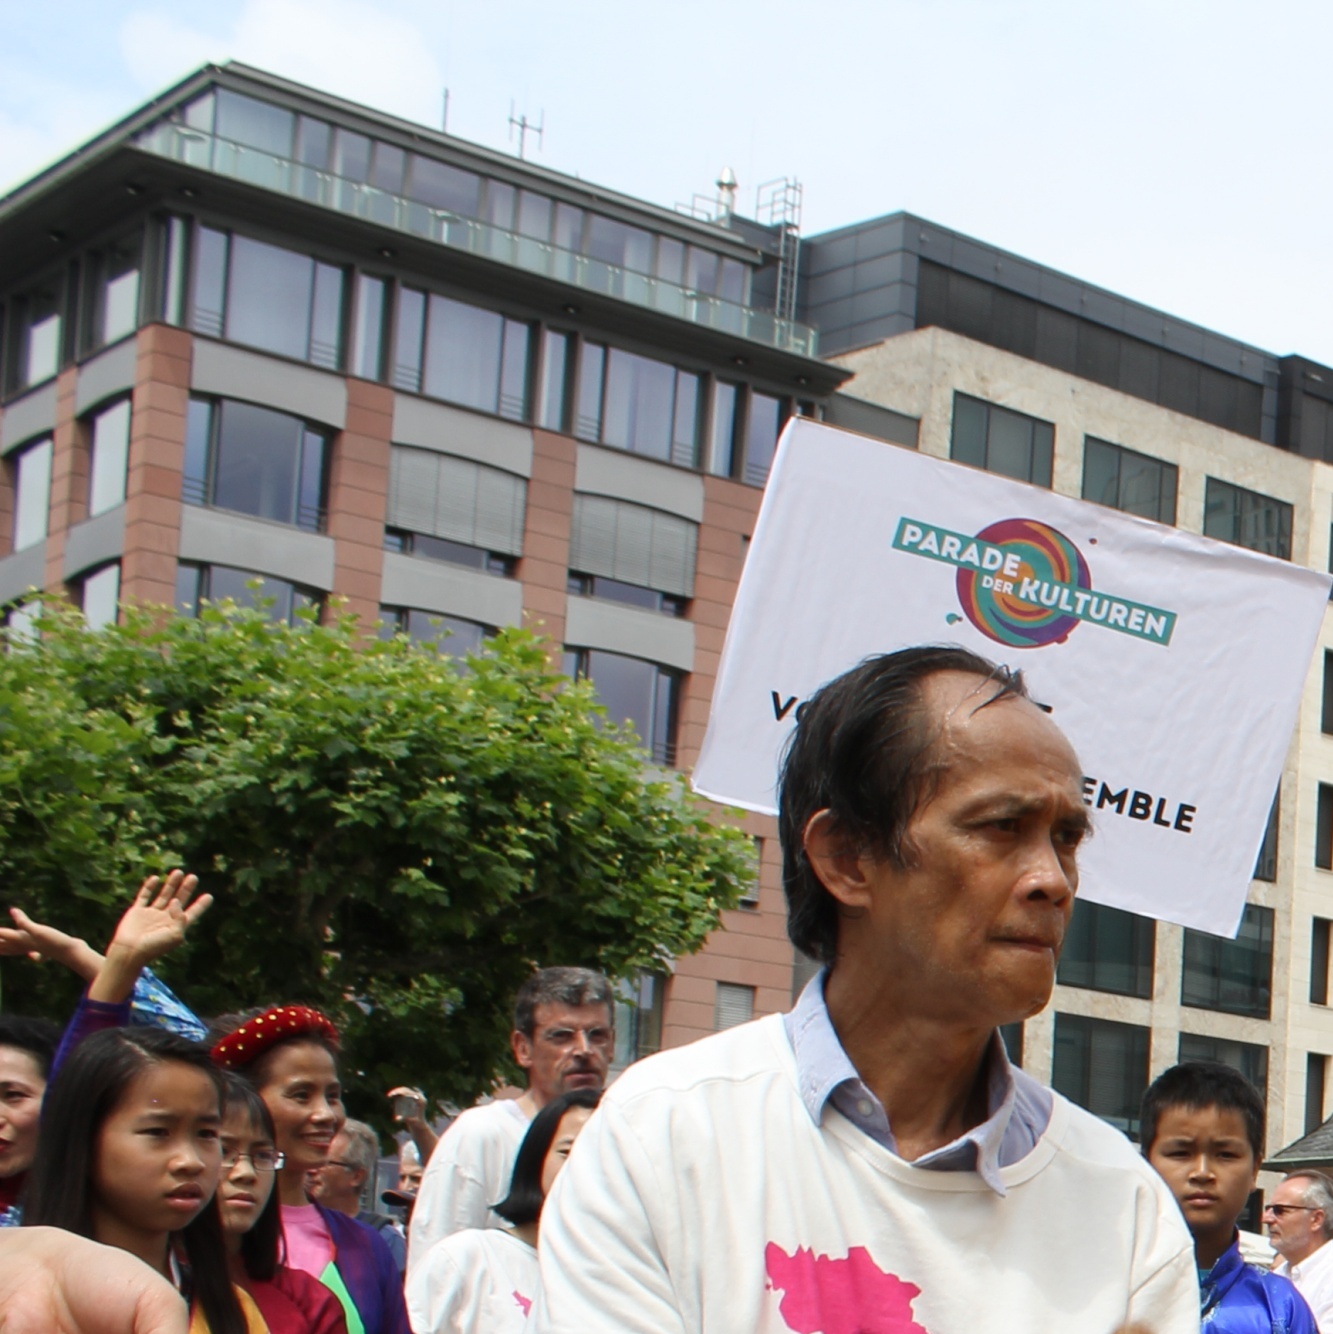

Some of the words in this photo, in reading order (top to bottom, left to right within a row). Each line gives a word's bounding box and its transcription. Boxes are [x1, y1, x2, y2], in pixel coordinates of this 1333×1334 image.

[900, 523, 1022, 579] PARADE
[981, 574, 1015, 596] DER
[1018, 576, 1168, 639] KULTUREN
[1082, 776, 1197, 834] EMBLE
